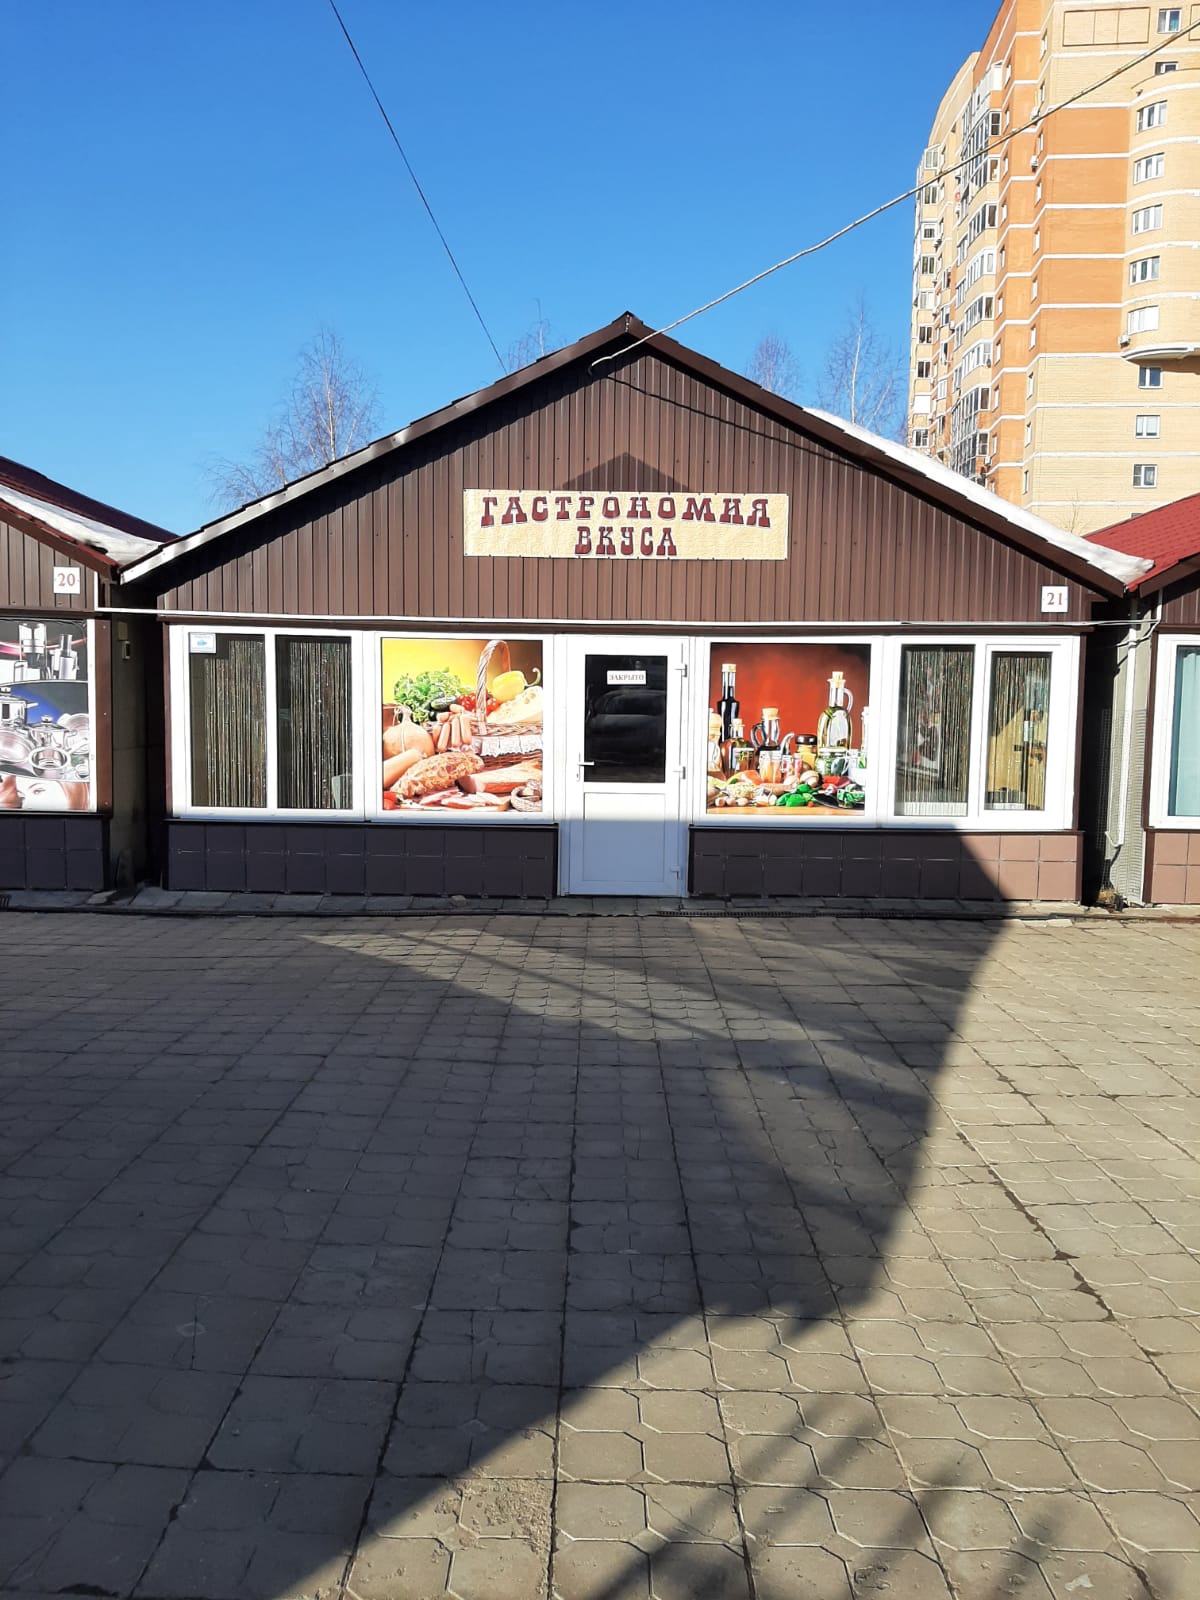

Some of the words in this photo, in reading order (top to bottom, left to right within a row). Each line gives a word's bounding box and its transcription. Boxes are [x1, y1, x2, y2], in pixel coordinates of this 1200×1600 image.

[480, 496, 771, 528] ГАСТРОНОМИЯ
[574, 526, 678, 556] ВКУСА
[57, 572, 76, 587] 20
[1046, 592, 1063, 606] 21
[608, 673, 645, 681] ЗАКРЫТО
